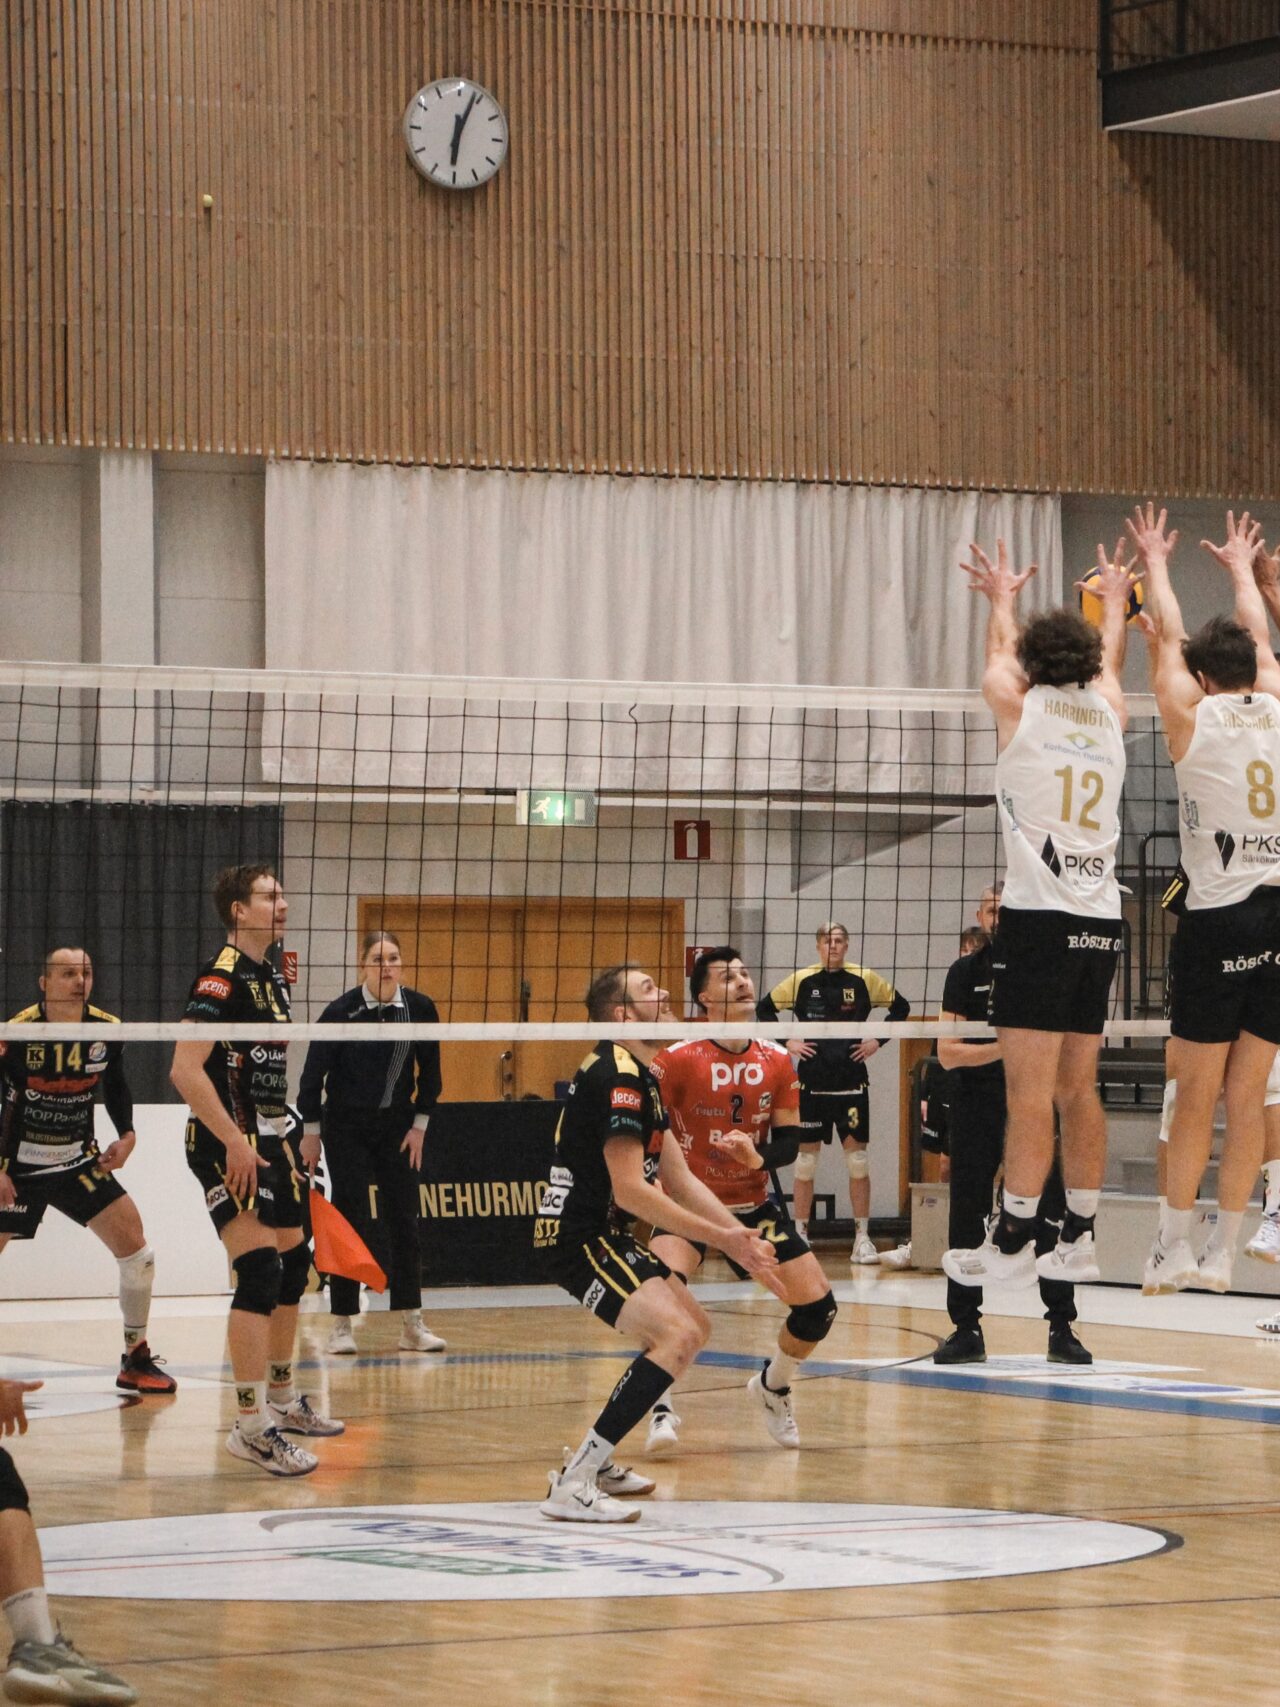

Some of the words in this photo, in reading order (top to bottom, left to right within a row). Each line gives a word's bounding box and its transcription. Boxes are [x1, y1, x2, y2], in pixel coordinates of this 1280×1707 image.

[1054, 765, 1104, 831] 12
[1246, 760, 1275, 818] 8
[1065, 855, 1104, 878] PKS
[1113, 939, 1121, 951] O
[53, 1042, 82, 1072] 14
[711, 1062, 764, 1092] pro
[731, 1094, 744, 1125] 2
[848, 1107, 859, 1129] 3
